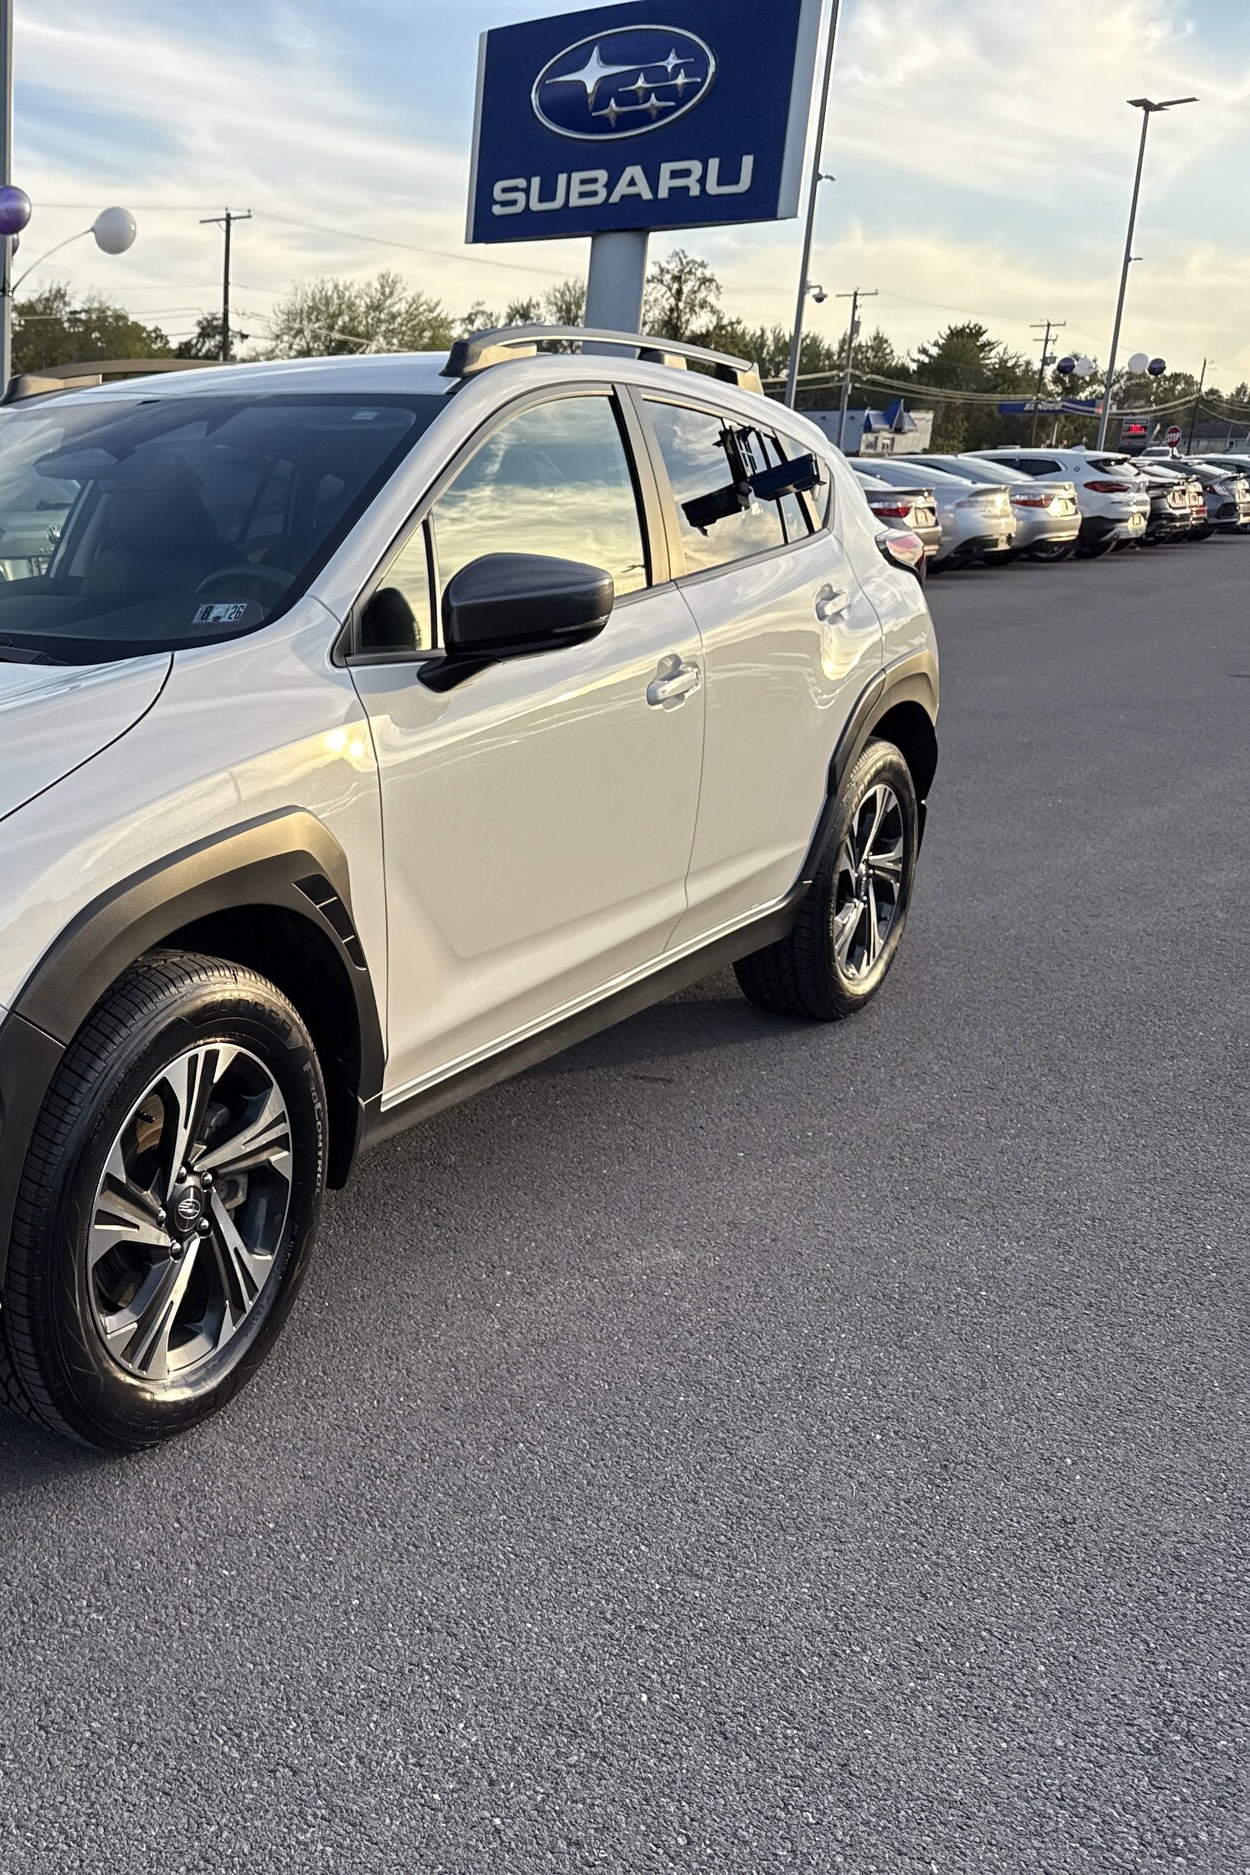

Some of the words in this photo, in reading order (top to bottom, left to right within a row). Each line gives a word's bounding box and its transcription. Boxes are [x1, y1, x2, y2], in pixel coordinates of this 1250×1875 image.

[491, 155, 754, 216] SUBARU
[1167, 432, 1180, 442] STOP
[228, 604, 245, 620] 26
